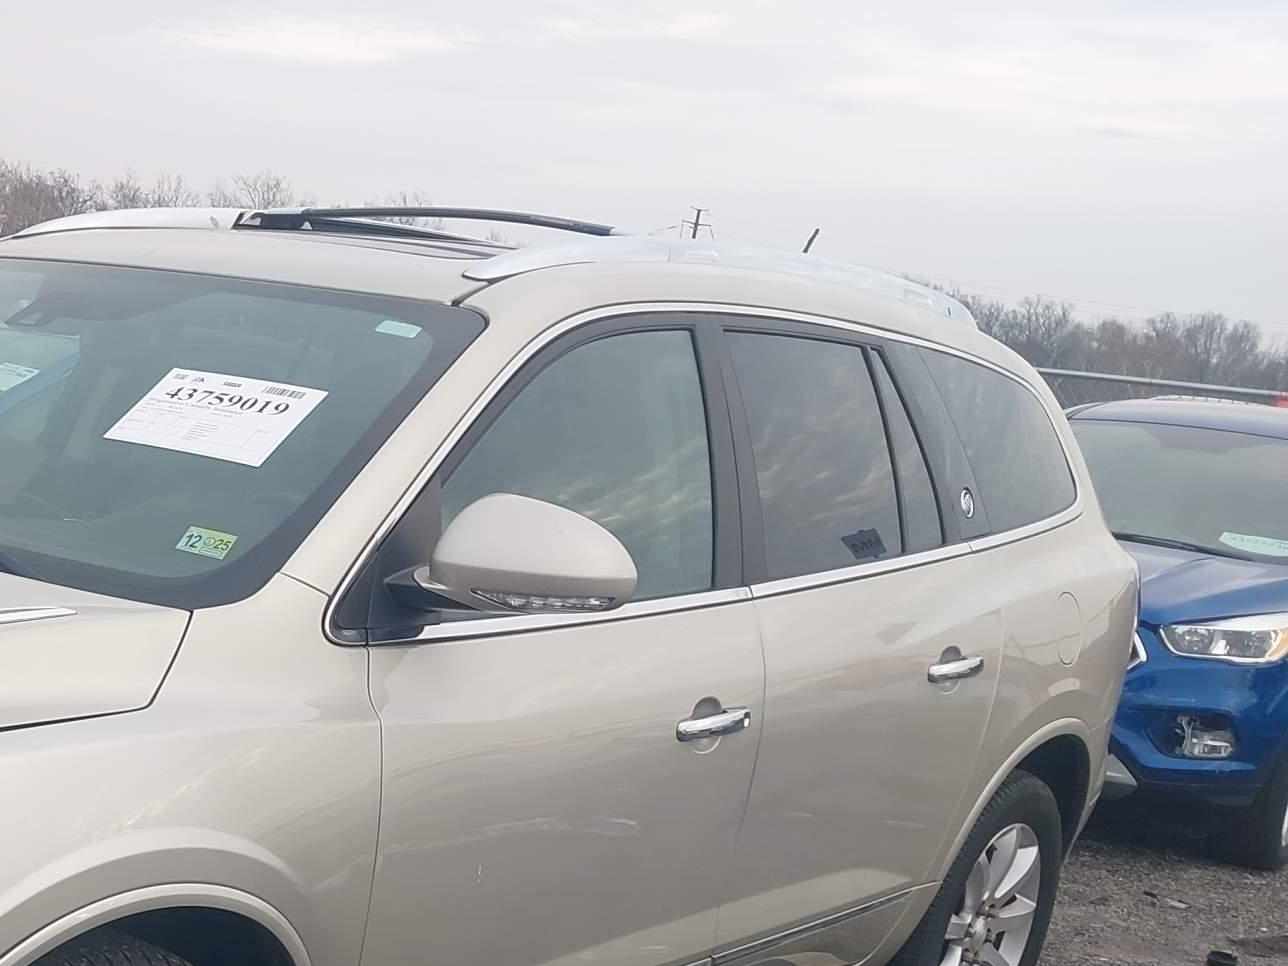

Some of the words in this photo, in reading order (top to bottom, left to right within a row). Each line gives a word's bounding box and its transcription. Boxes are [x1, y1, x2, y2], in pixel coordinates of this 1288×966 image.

[165, 386, 290, 416] 43759019
[184, 533, 202, 548] 12
[214, 539, 232, 551] 25
